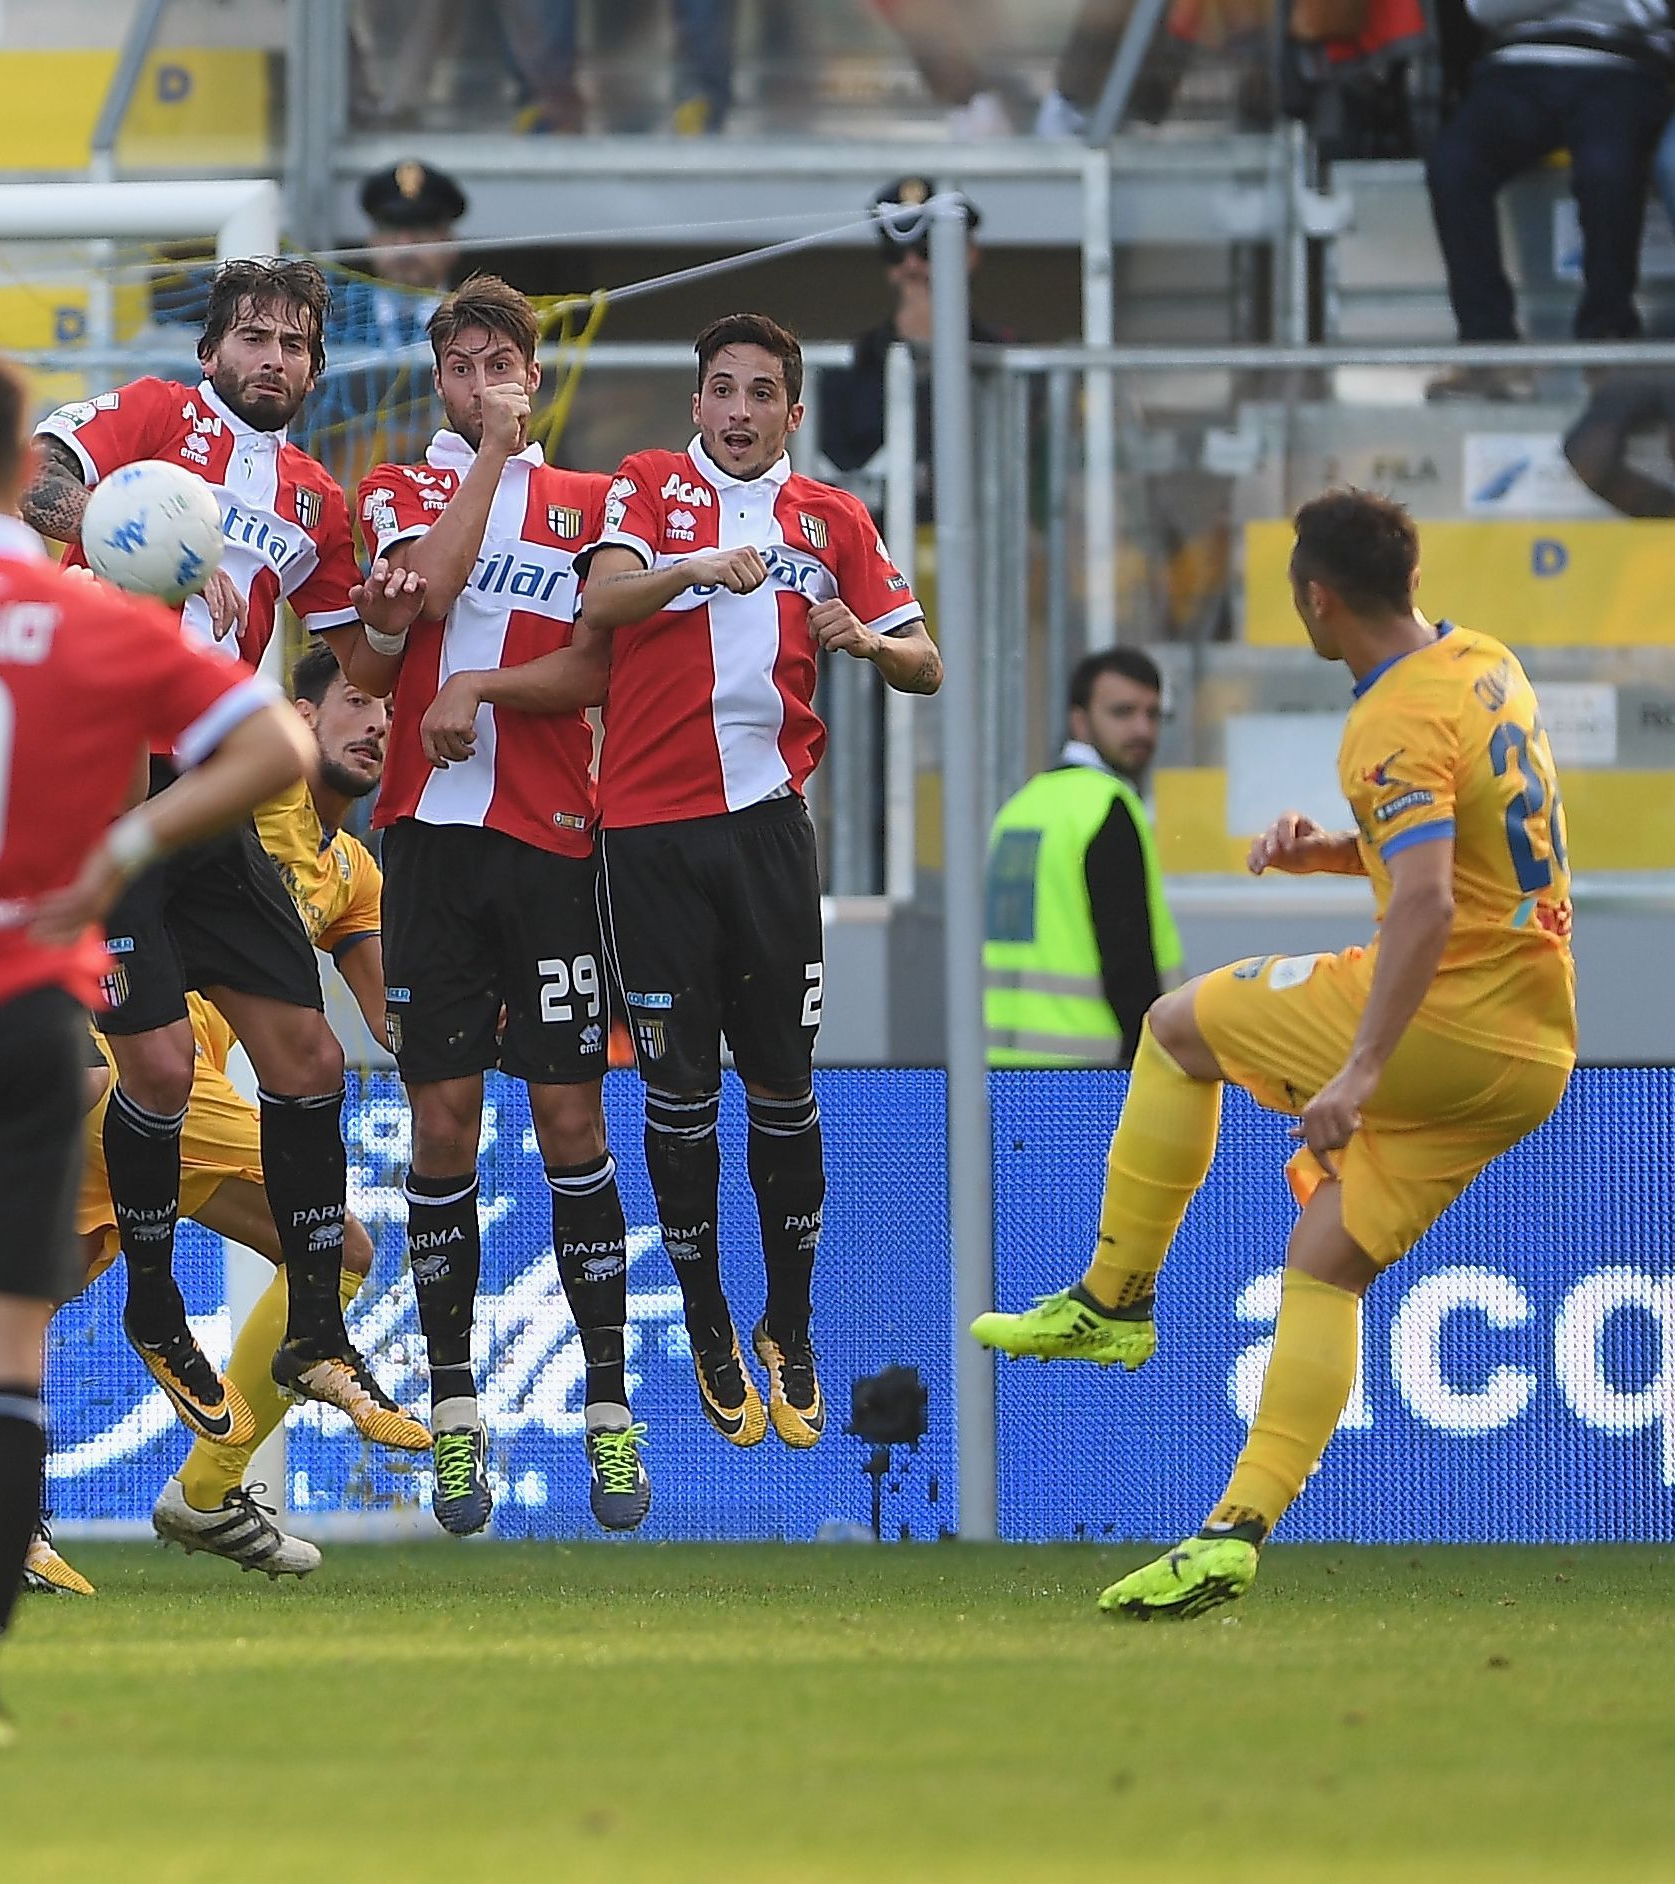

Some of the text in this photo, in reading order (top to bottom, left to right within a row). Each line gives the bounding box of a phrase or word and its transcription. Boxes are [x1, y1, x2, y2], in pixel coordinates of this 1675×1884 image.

[157, 65, 192, 103] D
[55, 308, 86, 341] D
[224, 506, 304, 572] tilar
[1530, 537, 1568, 577] D
[467, 553, 570, 602] ilar
[537, 953, 601, 1024] 29
[291, 1203, 347, 1228] PARM
[660, 1220, 711, 1240] ARMA
[409, 1226, 466, 1251] ARMA
[562, 1239, 626, 1258] PARM
